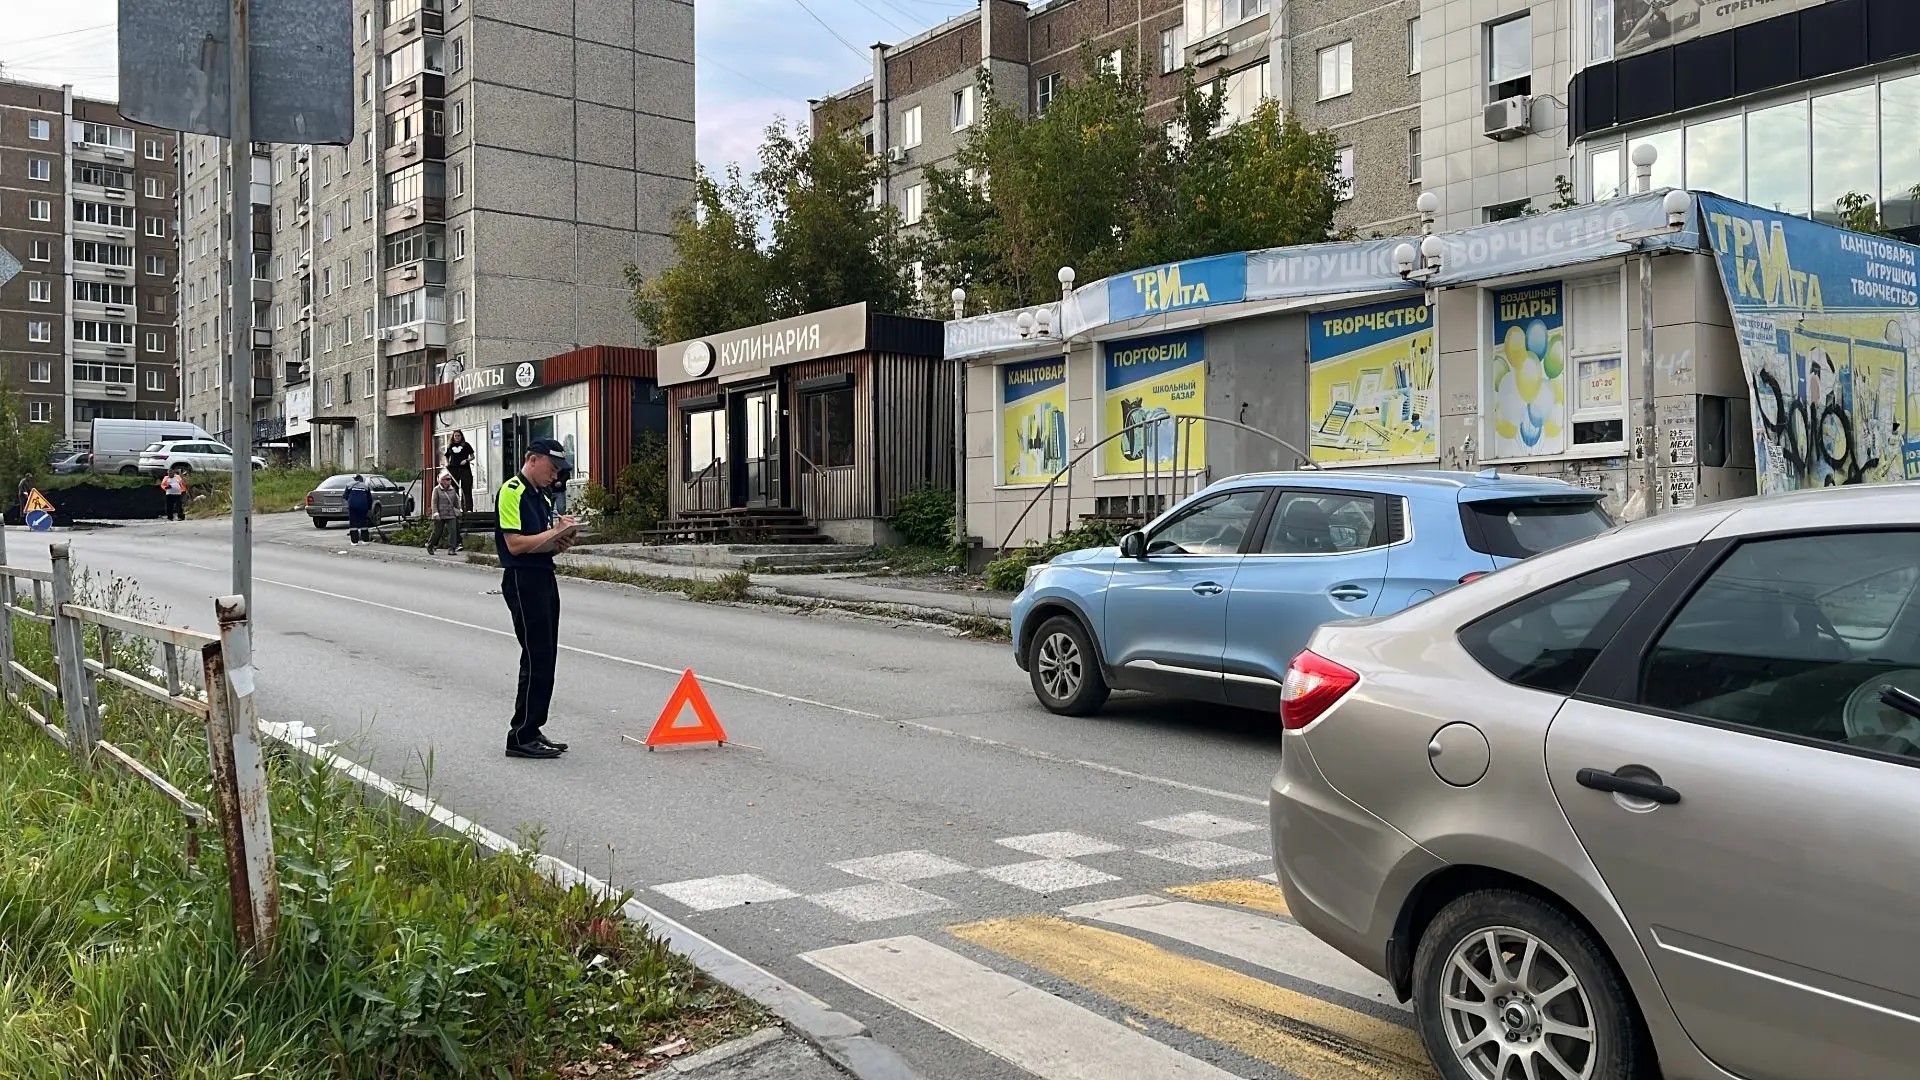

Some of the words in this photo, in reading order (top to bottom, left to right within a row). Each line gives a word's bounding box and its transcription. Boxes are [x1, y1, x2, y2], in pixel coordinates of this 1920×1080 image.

[1840, 234, 1915, 265] КАНЦТОВАРЫ
[1866, 261, 1917, 287] ИГРУШКИ
[1500, 287, 1557, 304] ВОЗДУШНЫЕ
[1850, 278, 1918, 306] ТВОРЧЕСТВО
[1322, 305, 1429, 337] ТВОРЧЕСТВО
[1501, 298, 1557, 322] ШАРЫ
[720, 324, 820, 366] КУЛИНАРИЯ
[1113, 342, 1188, 368] ПОРТФЕЛИ
[518, 366, 531, 377] 24
[1152, 380, 1196, 394] ШКОЛЬНЫЙ
[1170, 391, 1196, 401] БАЗАР
[1670, 440, 1693, 449] МЕХА
[1670, 482, 1694, 491] МЕХА
